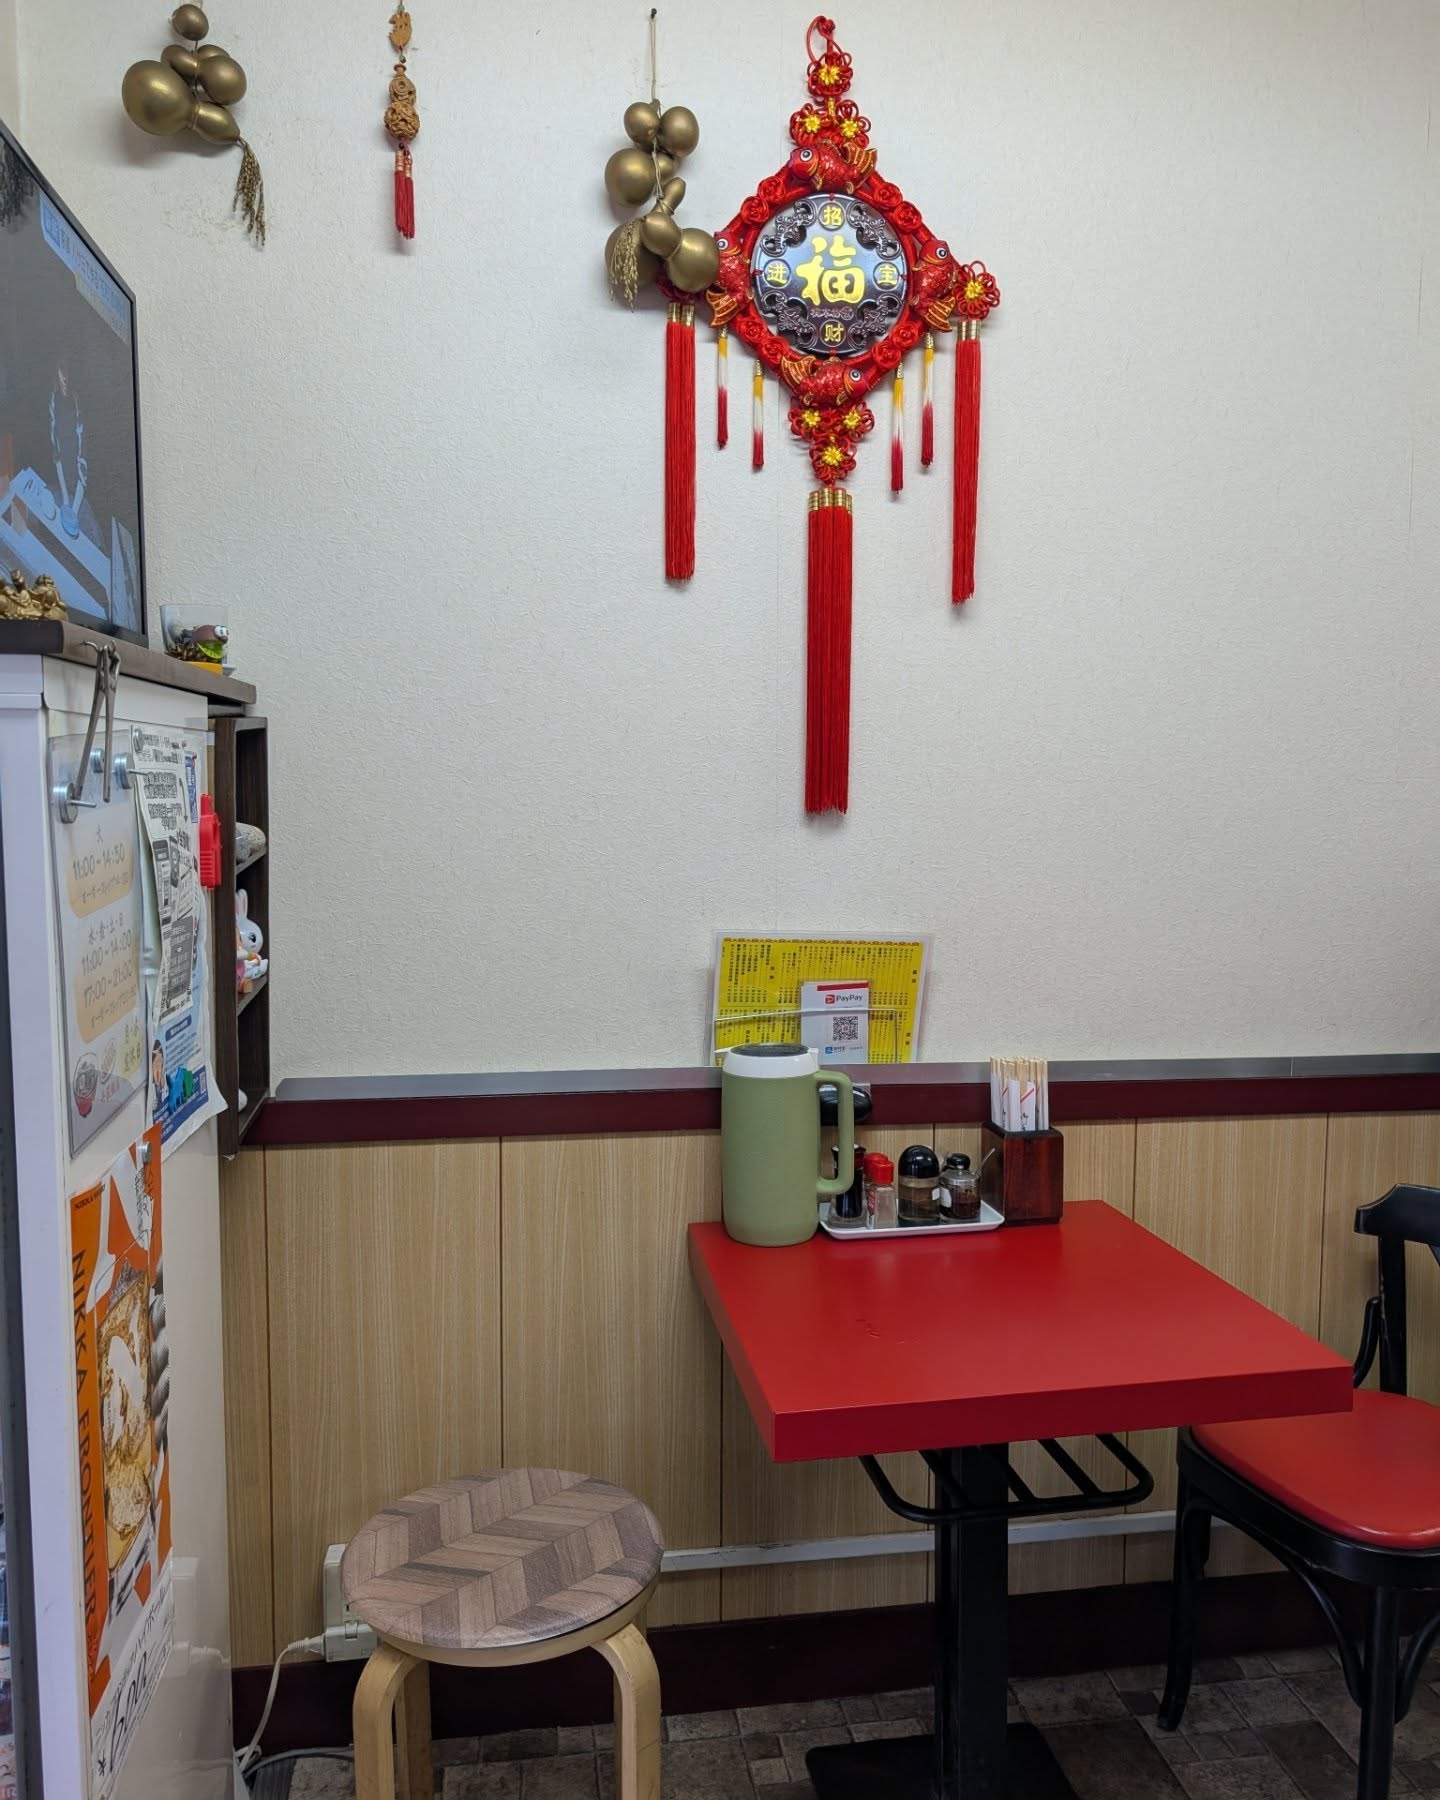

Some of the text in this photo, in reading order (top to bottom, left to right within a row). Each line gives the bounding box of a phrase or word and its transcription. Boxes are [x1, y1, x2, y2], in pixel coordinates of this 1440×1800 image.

[824, 205, 842, 226] 招
[766, 264, 788, 284] 进
[795, 234, 865, 306] 福
[876, 265, 898, 285] 宝
[824, 324, 844, 342] 财
[836, 994, 864, 1003] PayPay
[72, 1249, 88, 1397] NIKKA
[77, 1407, 98, 1627] FRONTIER
